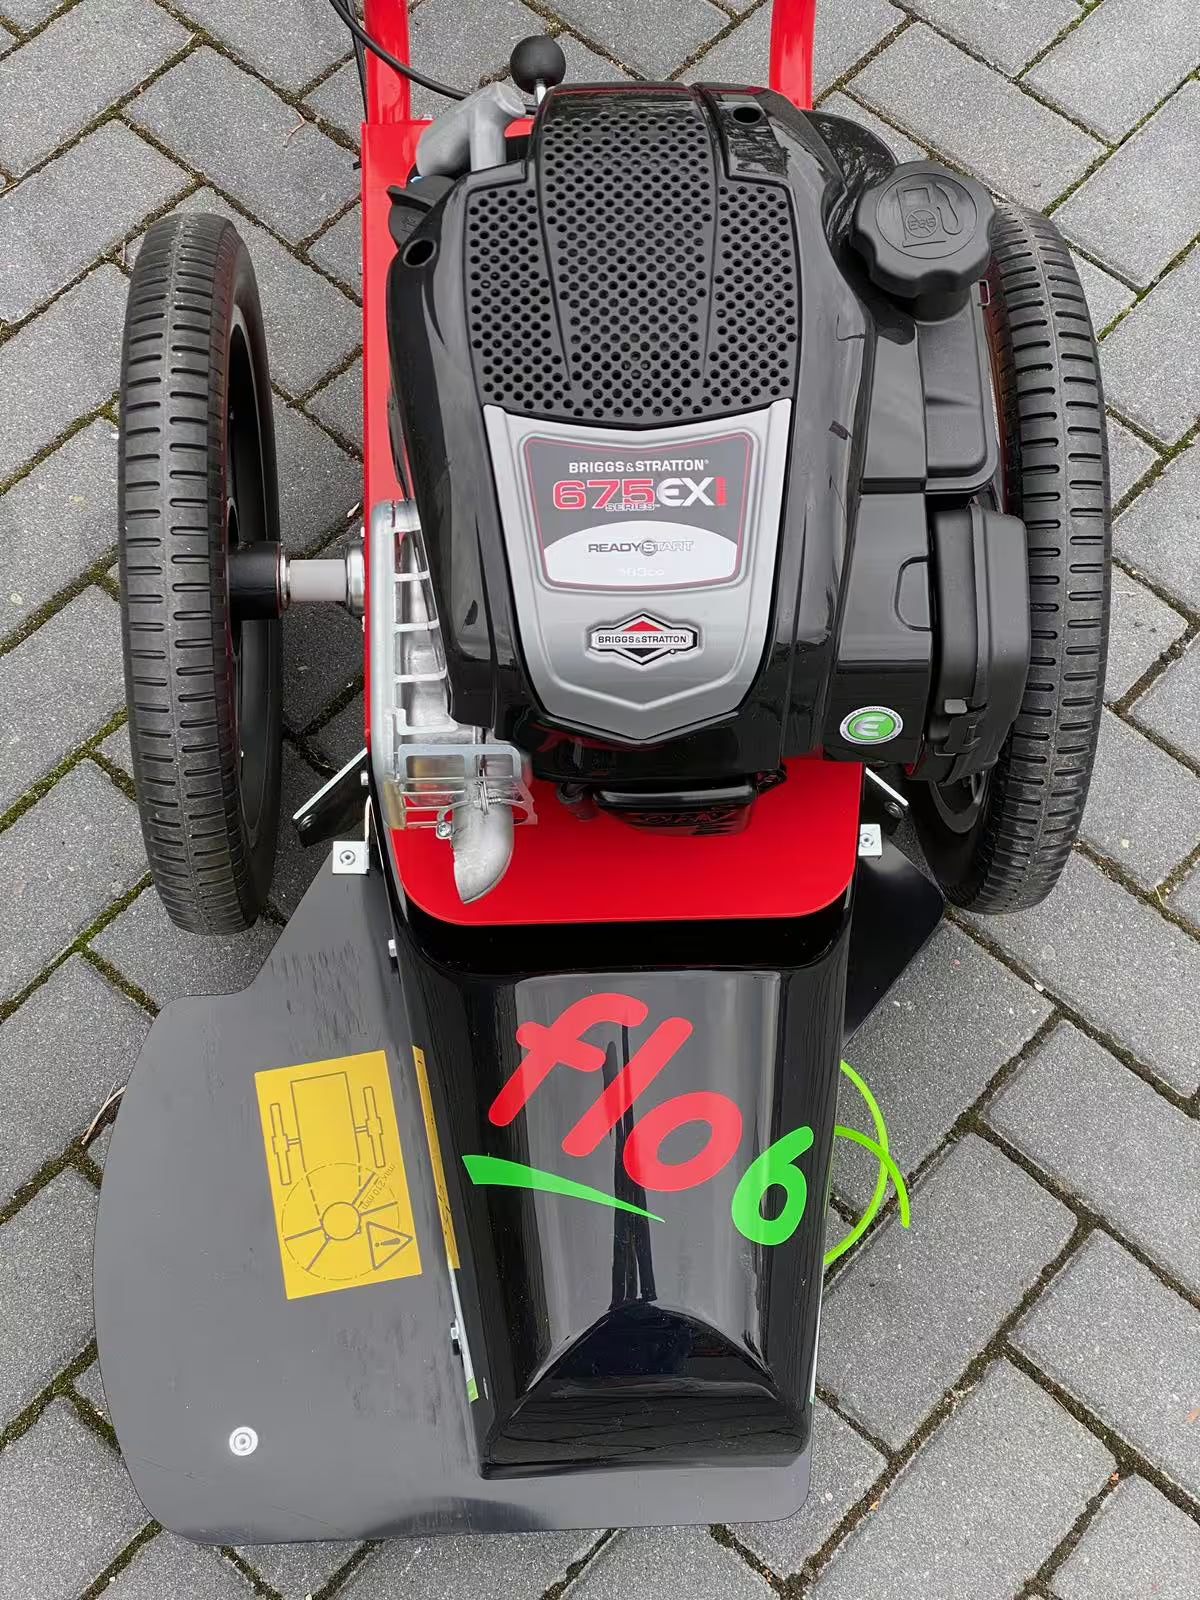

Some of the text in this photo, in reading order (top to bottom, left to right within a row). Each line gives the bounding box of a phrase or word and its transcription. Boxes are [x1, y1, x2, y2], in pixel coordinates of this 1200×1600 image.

[605, 502, 656, 512] SERIES
[598, 635, 687, 644] BRIGGS&STRATTON
[731, 1126, 814, 1246] 6
